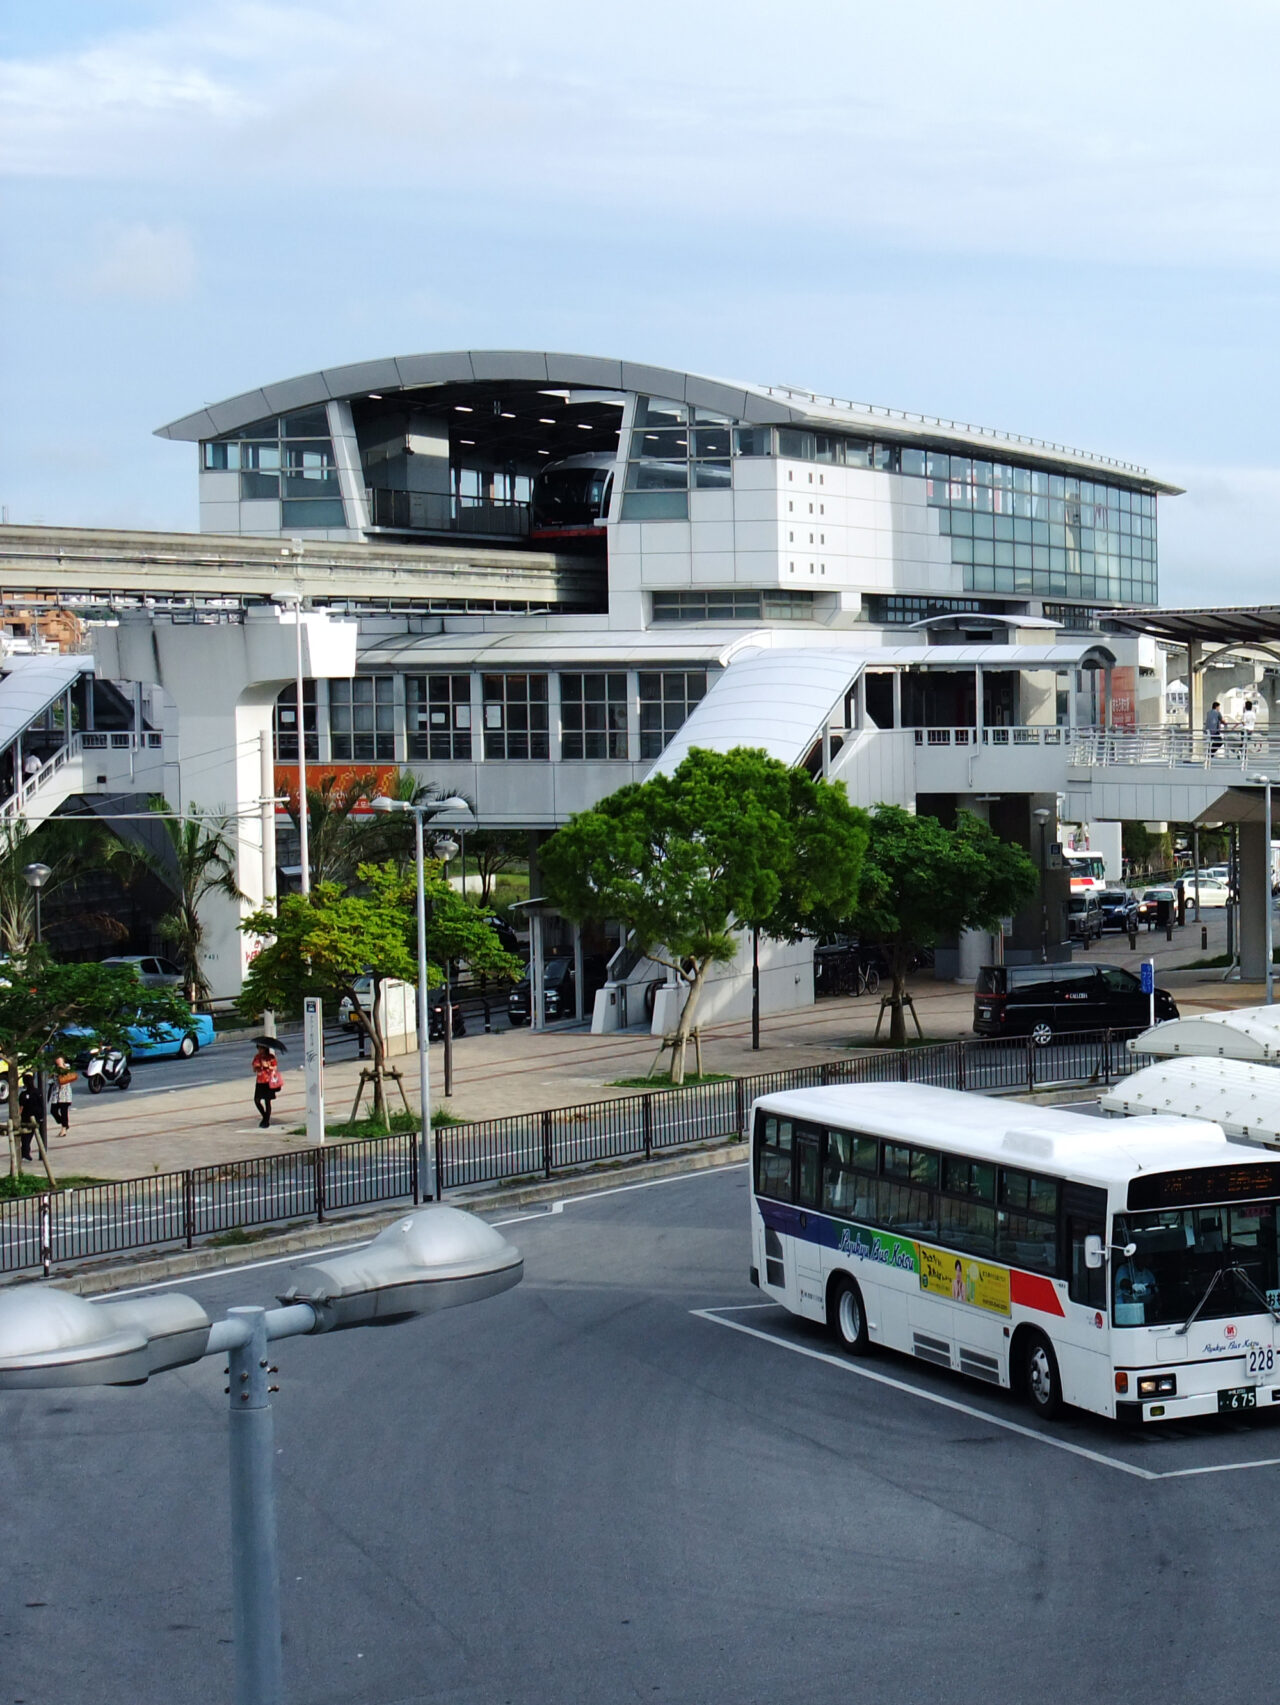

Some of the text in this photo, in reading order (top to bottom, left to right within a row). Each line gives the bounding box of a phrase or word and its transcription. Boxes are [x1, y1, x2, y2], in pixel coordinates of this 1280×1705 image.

[839, 1228, 870, 1261] Ryukyu
[868, 1237, 889, 1262] Bus
[888, 1242, 914, 1270] Kotsu
[1202, 1339, 1260, 1353] Ryukyu Bus Kotsu
[1249, 1349, 1274, 1372] 228
[1231, 1392, 1255, 1409] 675
